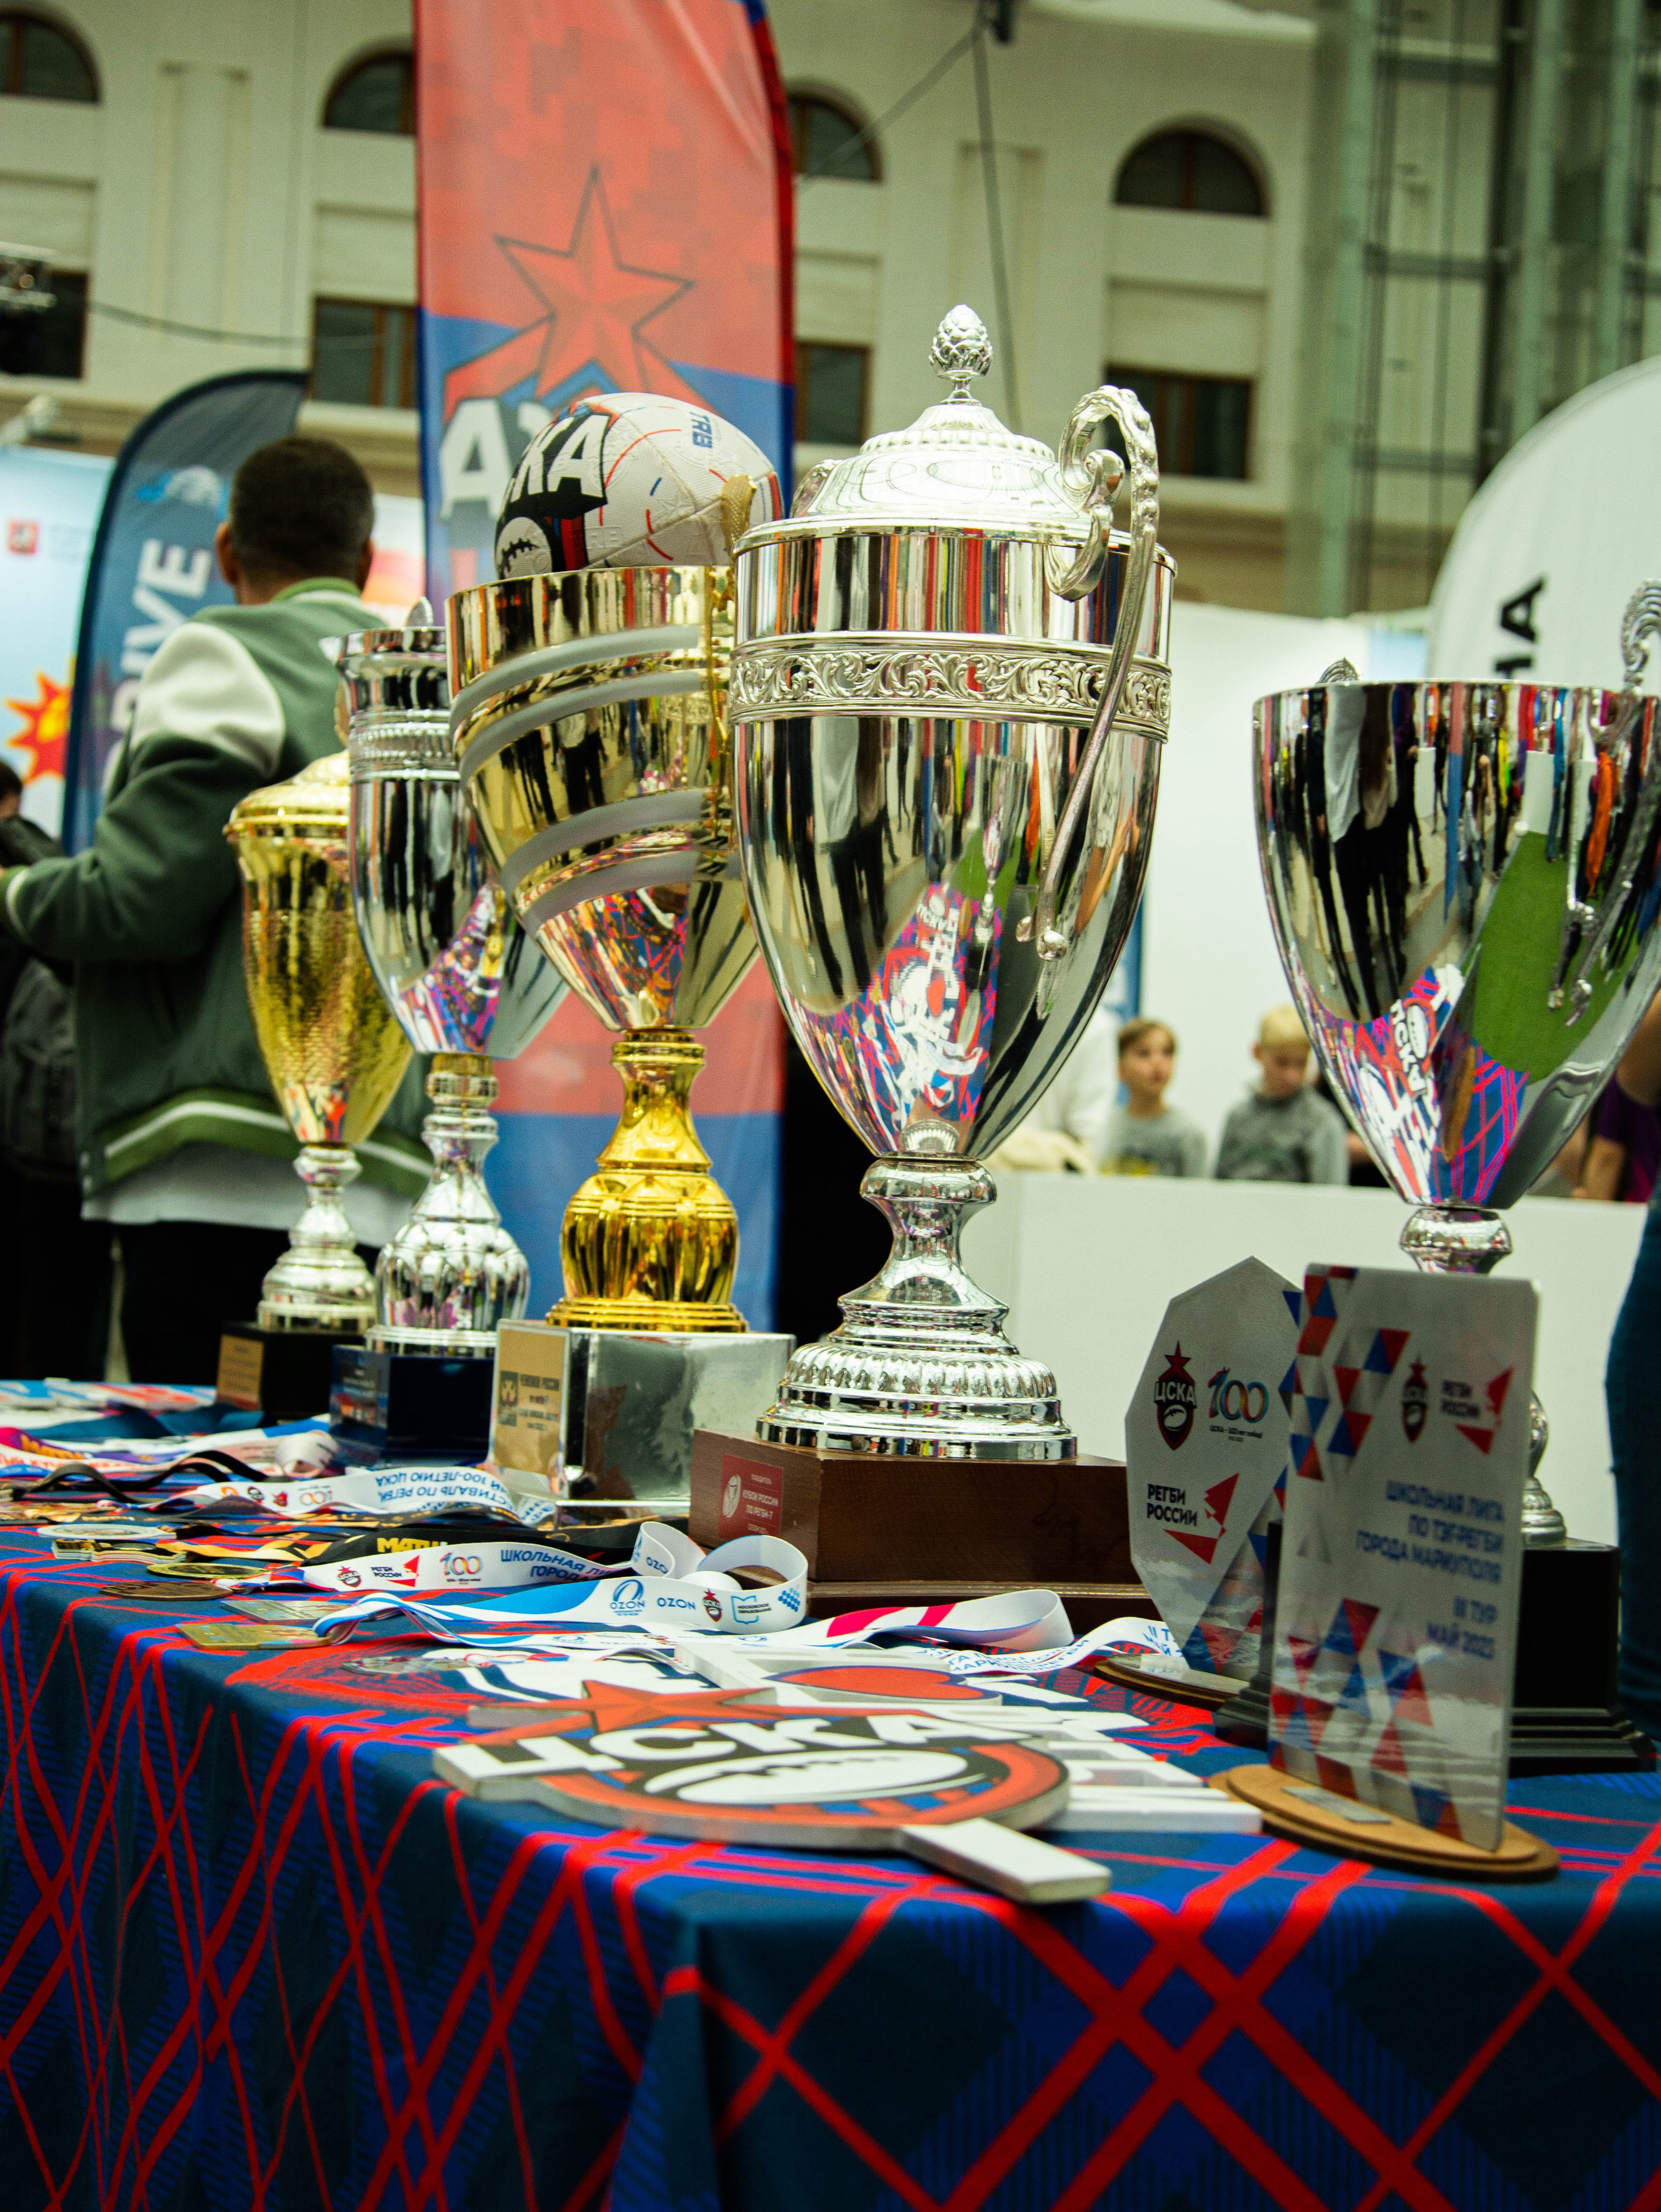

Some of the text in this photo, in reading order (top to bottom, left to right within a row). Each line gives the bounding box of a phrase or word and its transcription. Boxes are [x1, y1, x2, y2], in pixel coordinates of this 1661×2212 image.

[1154, 1381, 1196, 1406] ЦСКА
[376, 1472, 407, 1487] ЦСКА
[417, 1486, 435, 1498] ПО
[1148, 1484, 1185, 1505] РЕГБИ
[1146, 1502, 1198, 1526] РОССИИ
[501, 1549, 586, 1572] ШКОЛЬНАЯ
[610, 1600, 645, 1609] OZON
[657, 1598, 696, 1610] OZON
[433, 1714, 1037, 1779] ЦСКА
